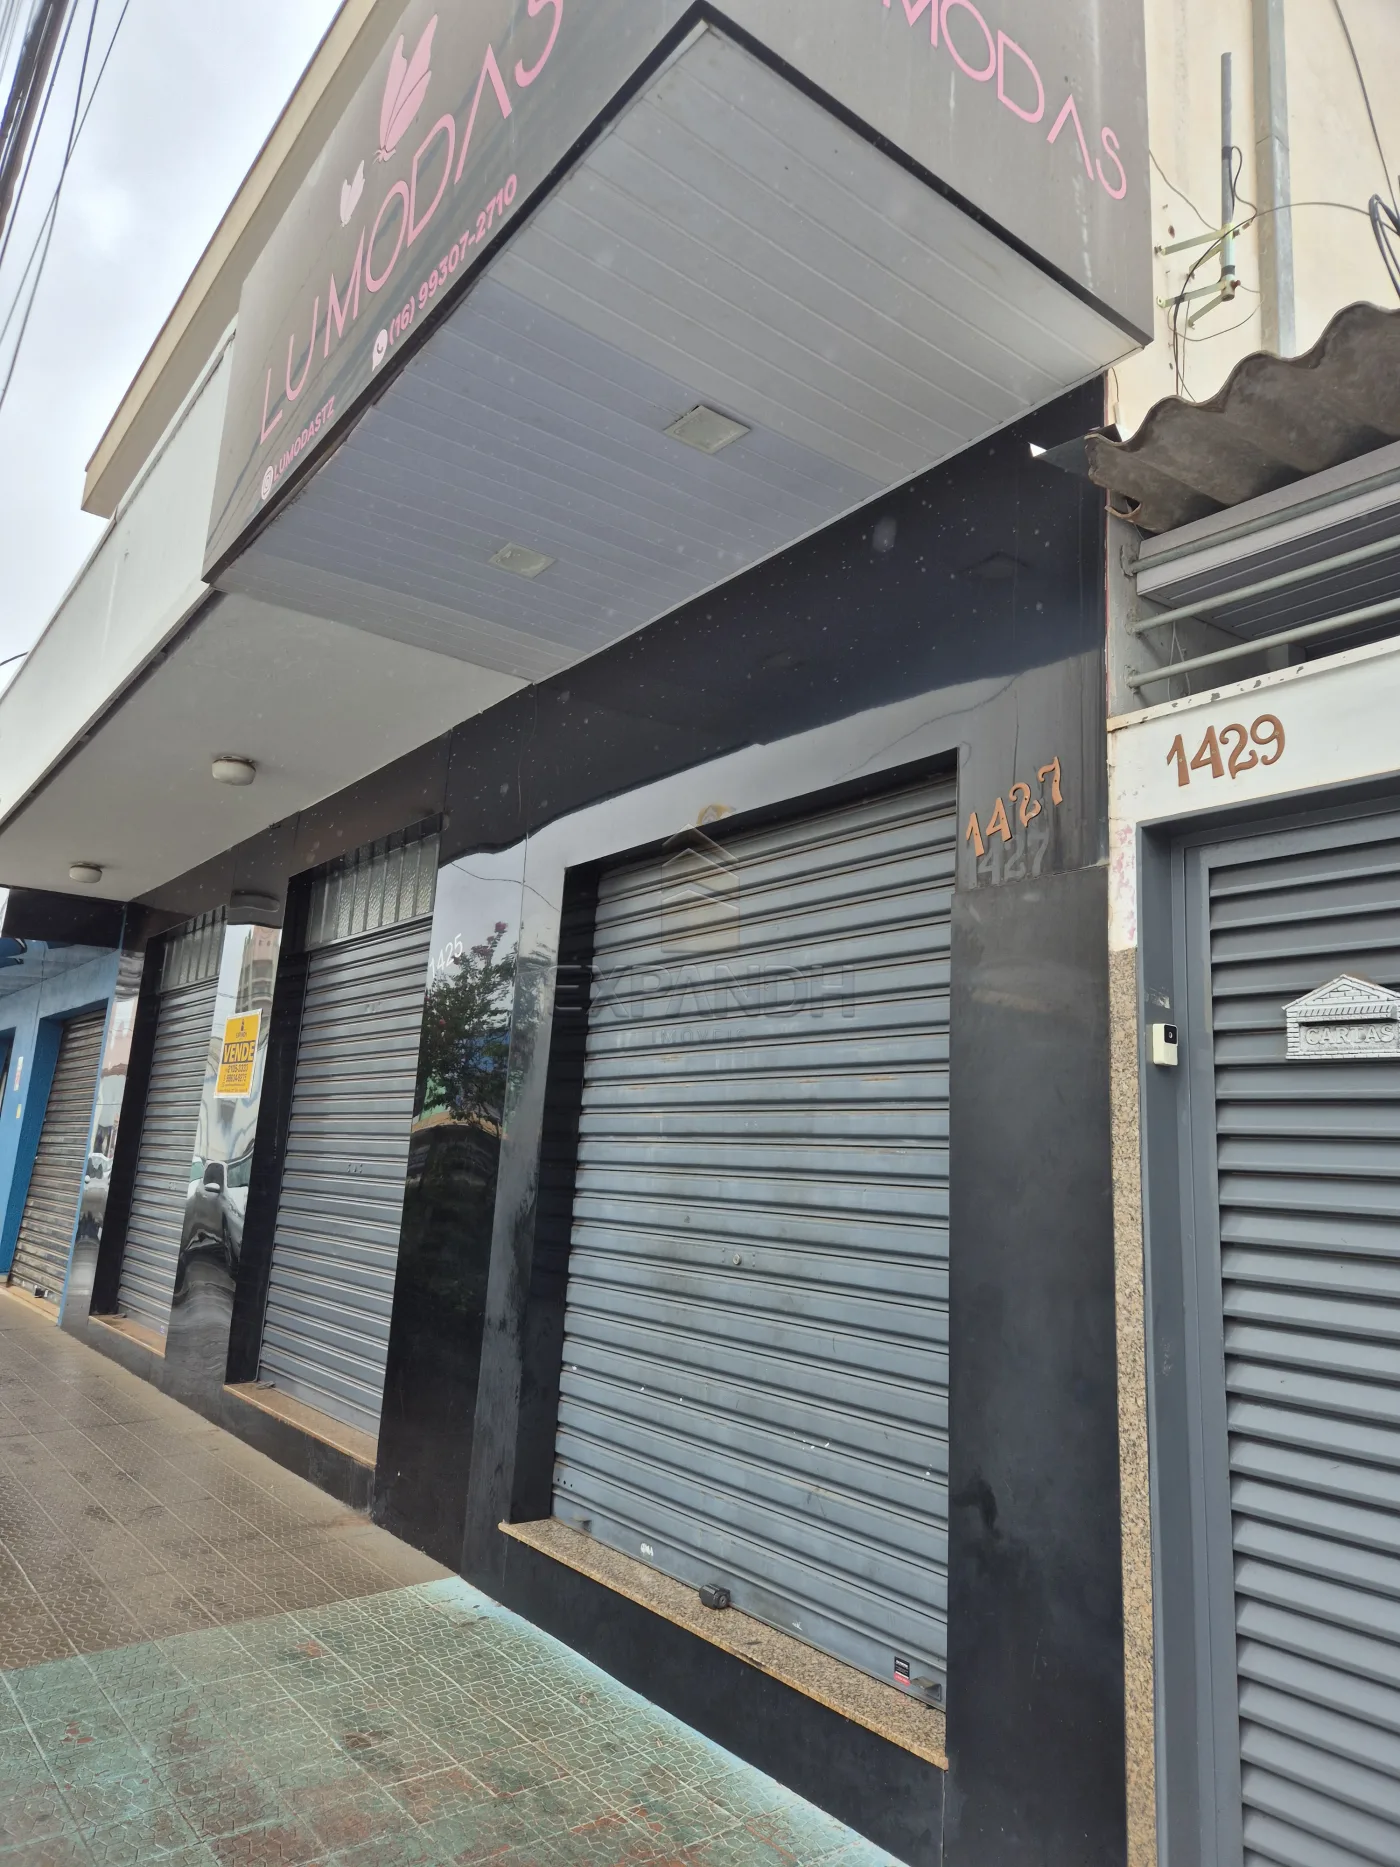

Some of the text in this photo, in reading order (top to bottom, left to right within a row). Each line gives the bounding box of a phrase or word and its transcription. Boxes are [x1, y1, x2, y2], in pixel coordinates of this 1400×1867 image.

[389, 173, 518, 346] (16) 99307-2710
[273, 394, 335, 482] LUMODASTZ
[1166, 713, 1286, 787] 1429
[965, 755, 1063, 857] 1427
[429, 932, 463, 979] 1425
[223, 1041, 255, 1064] VENDE
[1305, 1023, 1395, 1046] CARTAS
